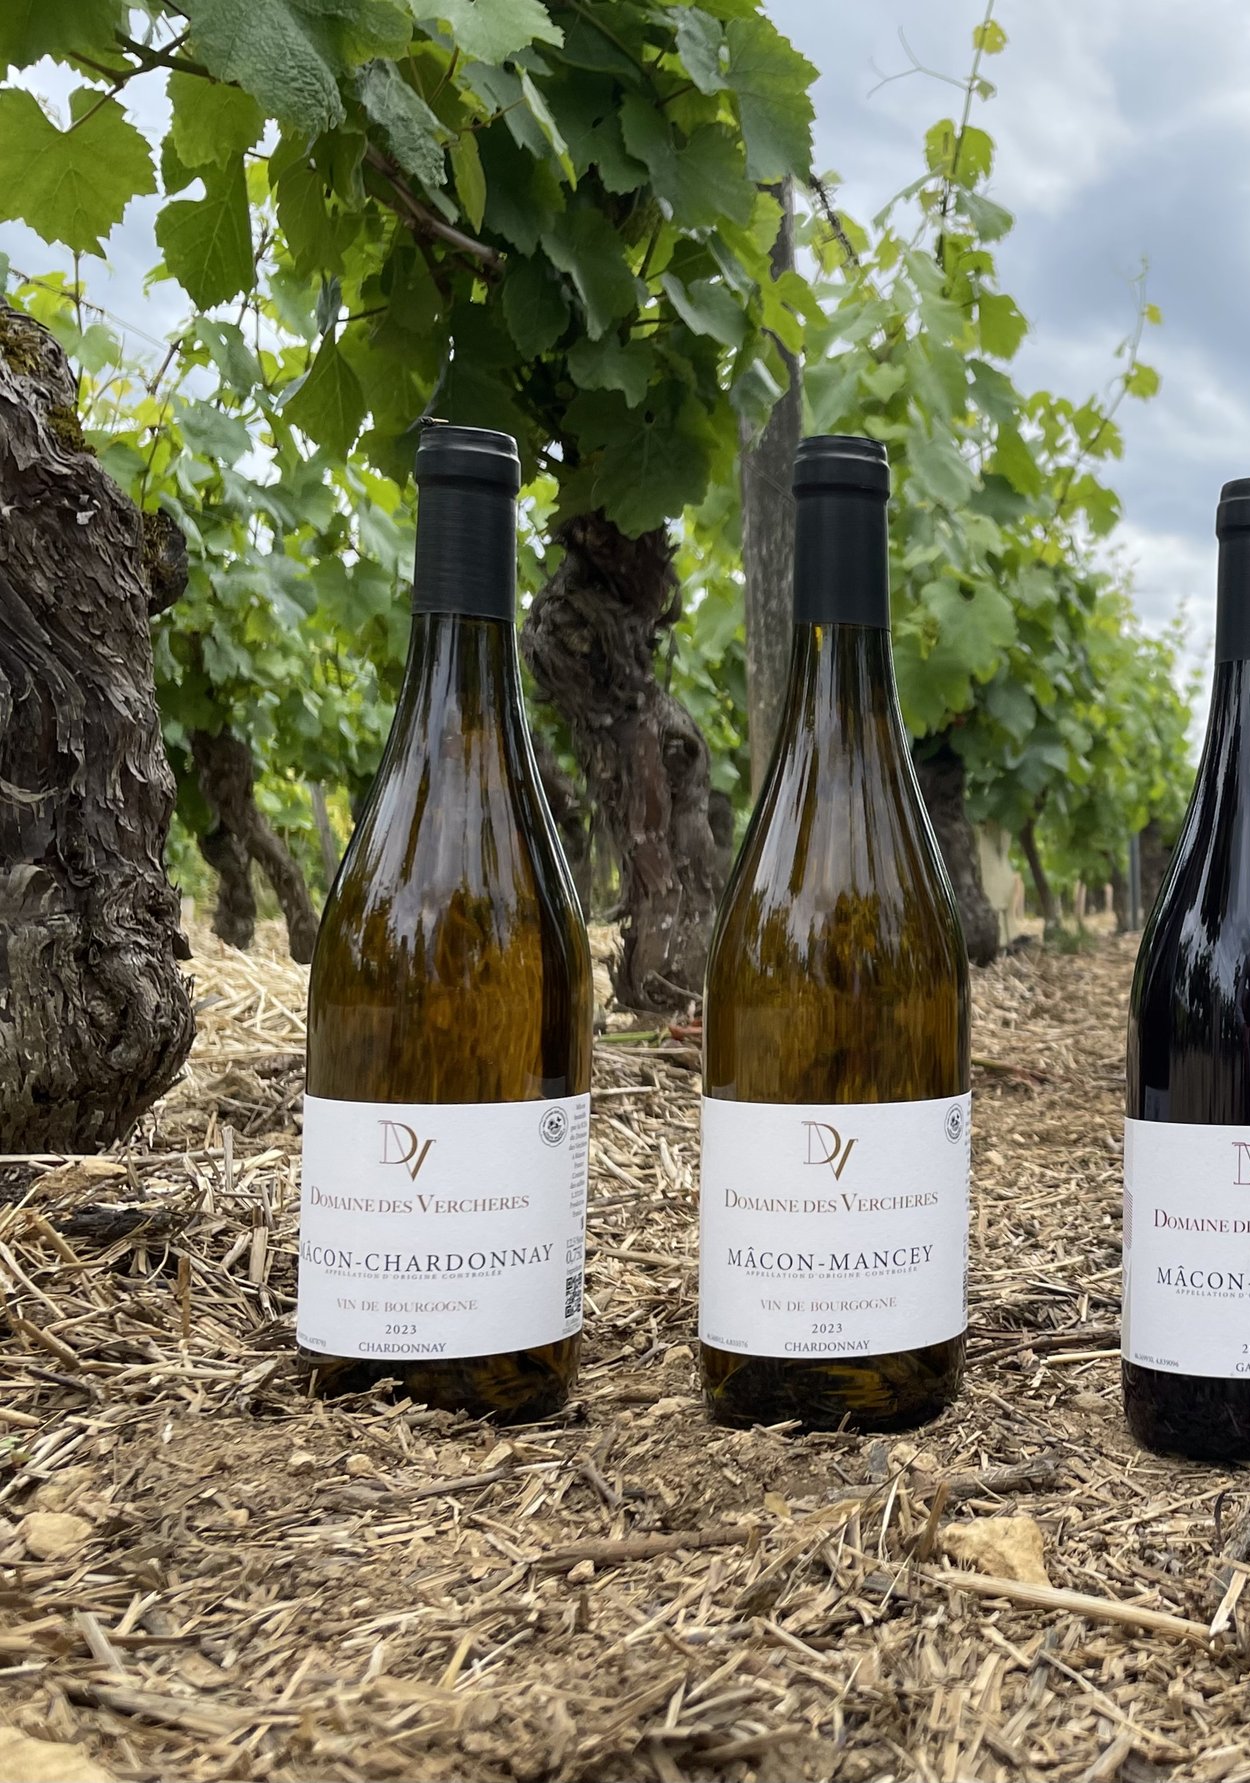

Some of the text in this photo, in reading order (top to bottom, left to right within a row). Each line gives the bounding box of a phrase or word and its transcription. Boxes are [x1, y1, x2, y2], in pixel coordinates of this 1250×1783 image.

[728, 1245, 933, 1271] MÂCON-MANCEY
[325, 1270, 380, 1279] APPELLATION
[746, 1270, 805, 1279] APPELLATION
[1176, 1289, 1235, 1298] APPELLATION
[337, 1298, 478, 1312] VIN DE BOURGOGNE
[760, 1297, 897, 1312] VIN DE BOURGOGNE
[385, 1324, 417, 1335] 2023
[811, 1323, 843, 1334] 2023
[358, 1342, 447, 1353] CHARDONNAY
[784, 1339, 870, 1352] CHARDONNAY
